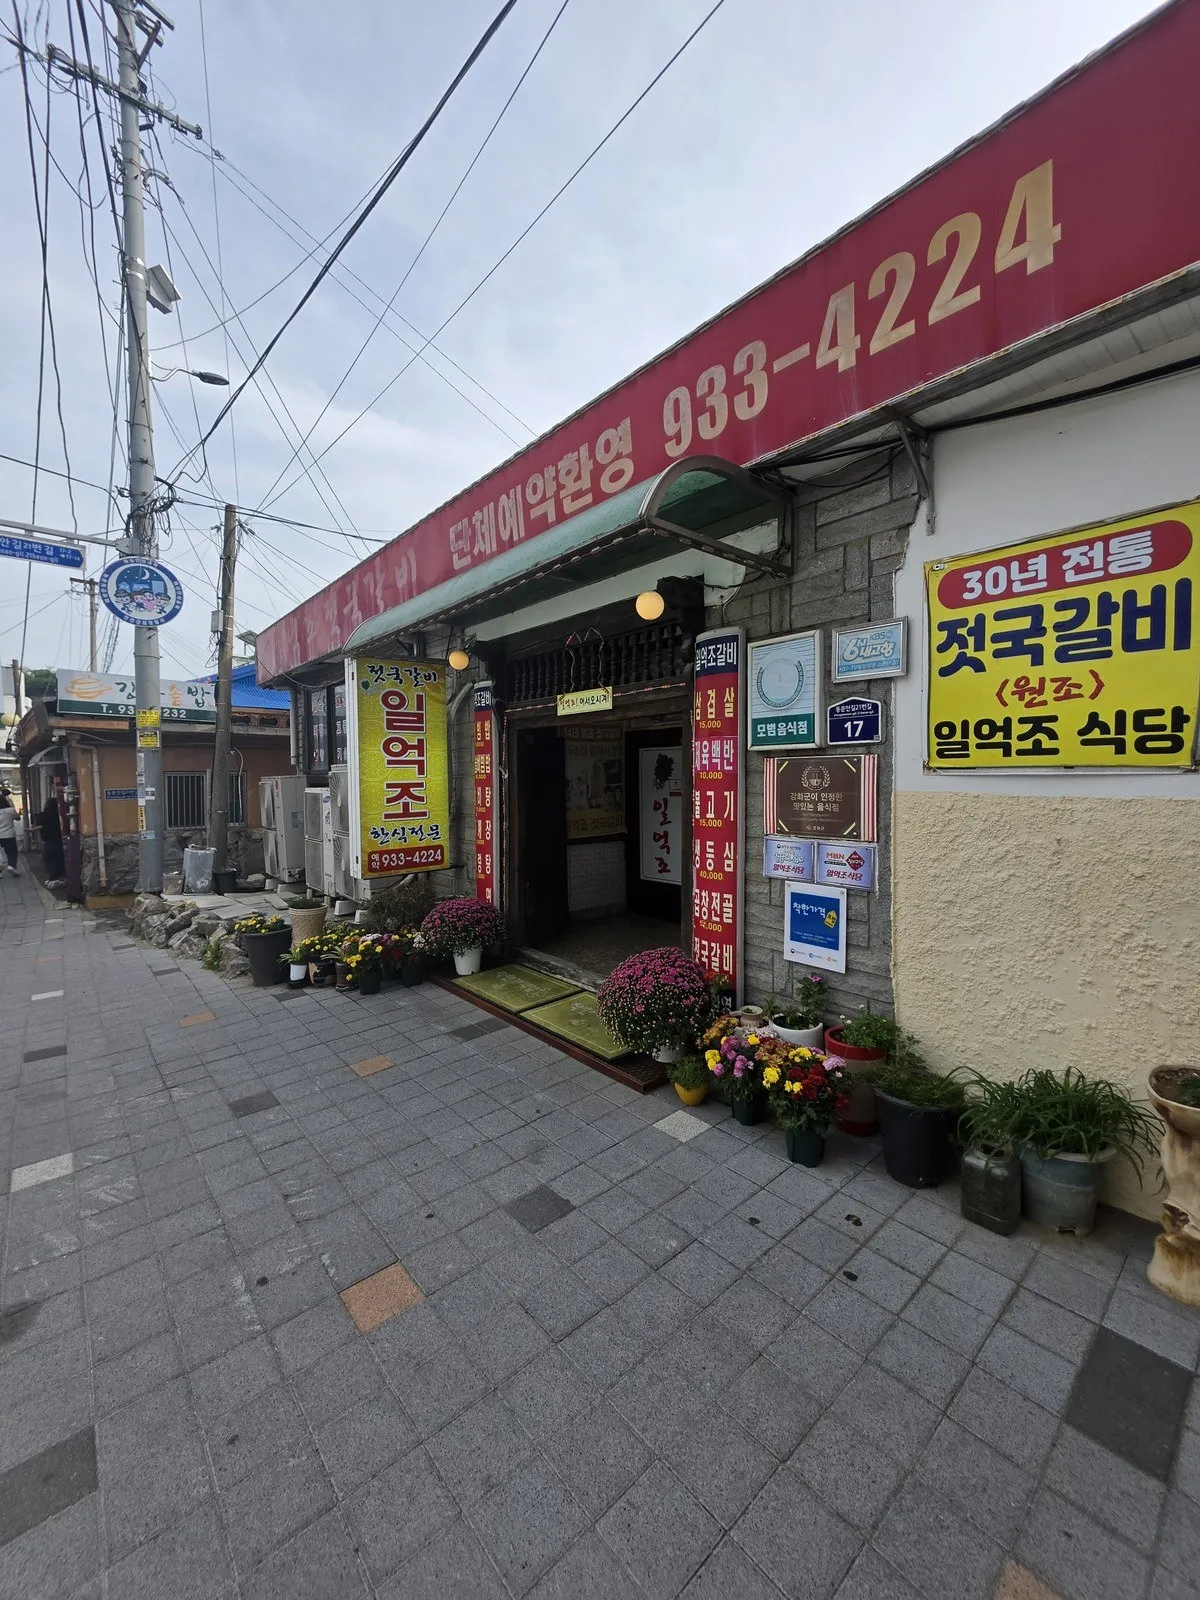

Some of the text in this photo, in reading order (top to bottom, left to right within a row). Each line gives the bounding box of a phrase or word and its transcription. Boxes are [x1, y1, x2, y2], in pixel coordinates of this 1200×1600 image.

[663, 158, 1062, 457] 933-4224
[449, 416, 635, 571] 단체예약환영
[962, 530, 1154, 600] 30년 전통
[869, 631, 886, 641] KBS
[936, 577, 1192, 678] 젓국갈비
[859, 641, 896, 660] 내고향
[366, 663, 438, 689] 젓국갈비
[114, 682, 211, 708] 김솥밥
[101, 703, 113, 714] T.
[757, 720, 808, 737] 모범음식점
[844, 720, 864, 738] 17
[934, 705, 1191, 759] 일억조 식당
[381, 689, 430, 822] 일억조
[790, 792, 818, 801] 강화군이
[793, 802, 839, 812] 맛있는 음식점
[370, 824, 442, 846] 한식전문
[653, 797, 671, 874] 일억조
[370, 853, 380, 870] 예약
[381, 849, 442, 868] 933-4224
[826, 852, 844, 860] MBN
[793, 901, 826, 918] 착한가격
